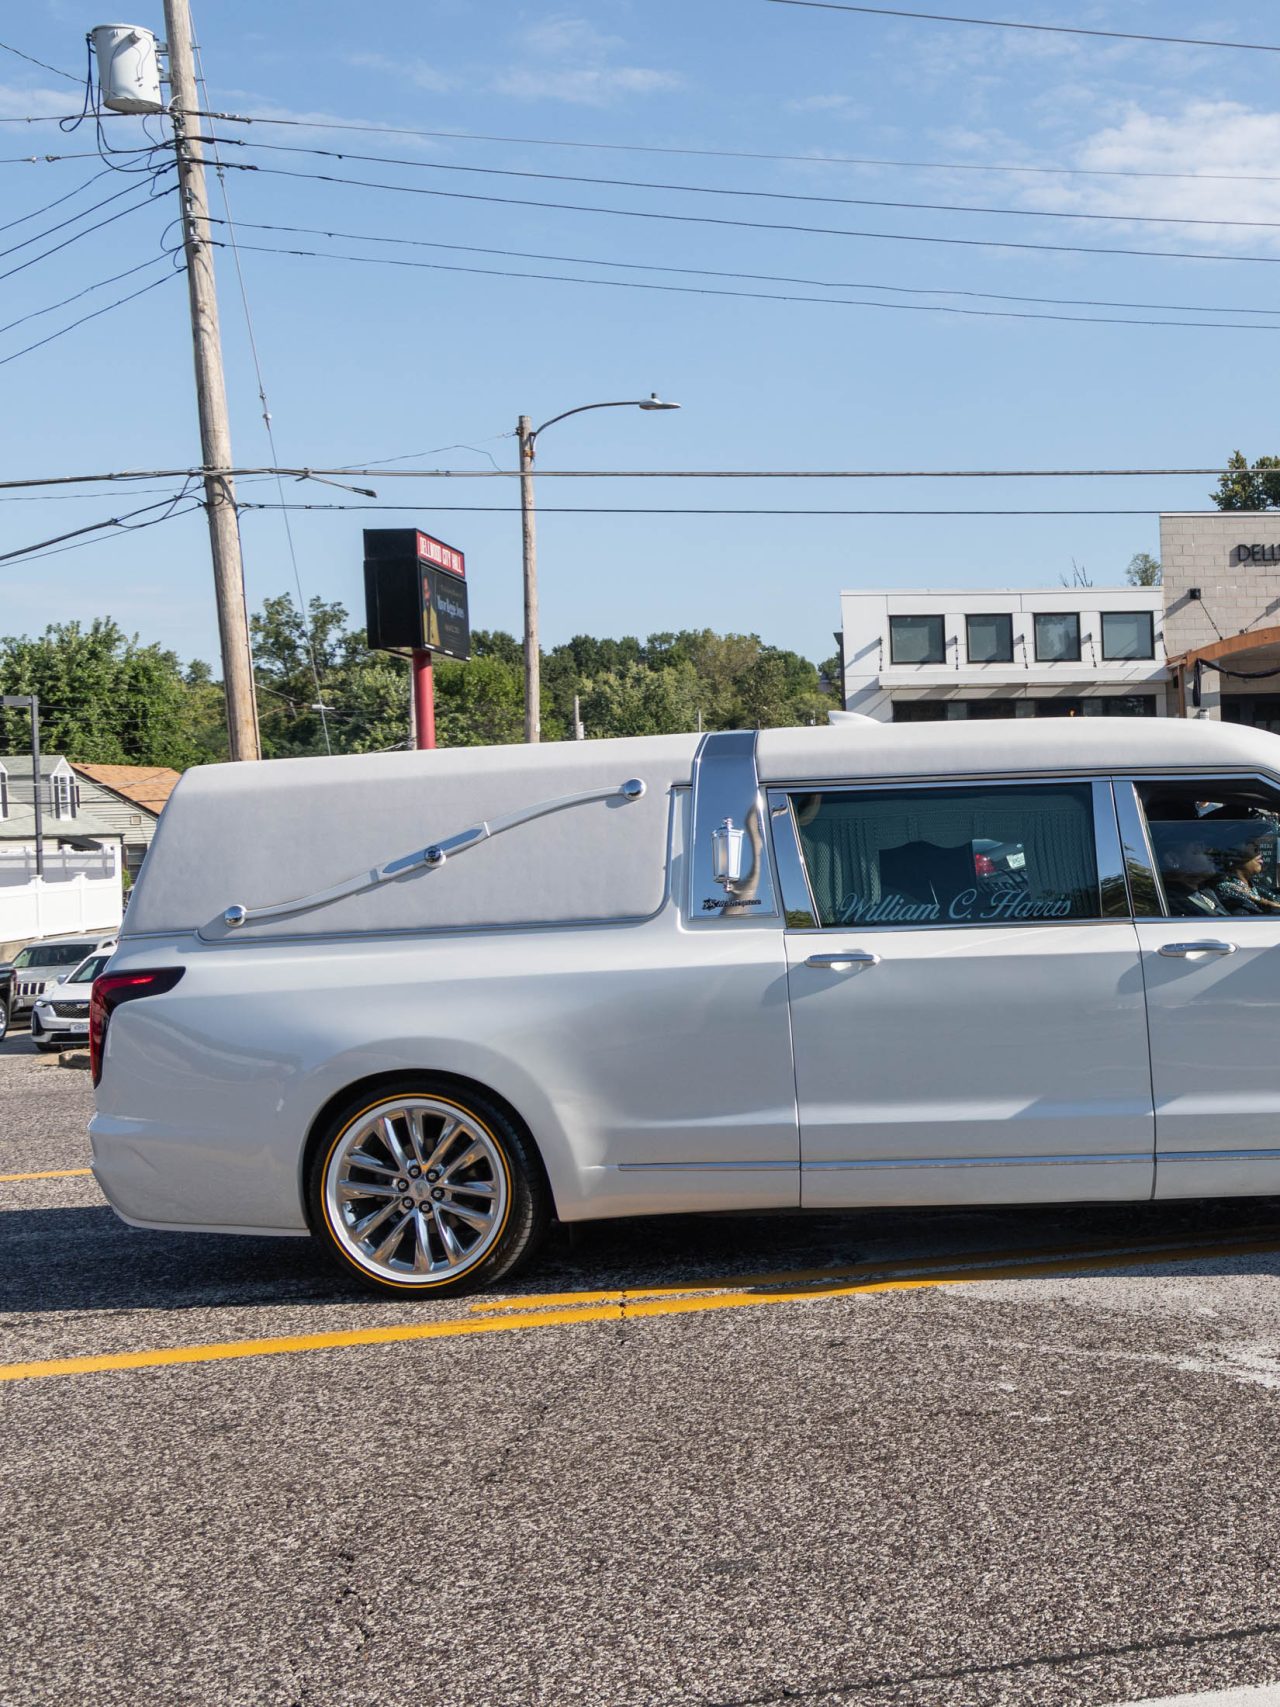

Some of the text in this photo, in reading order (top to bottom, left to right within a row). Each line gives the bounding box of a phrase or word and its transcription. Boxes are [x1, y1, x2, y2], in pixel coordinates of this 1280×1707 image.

[840, 888, 1071, 922] William C. Harris
